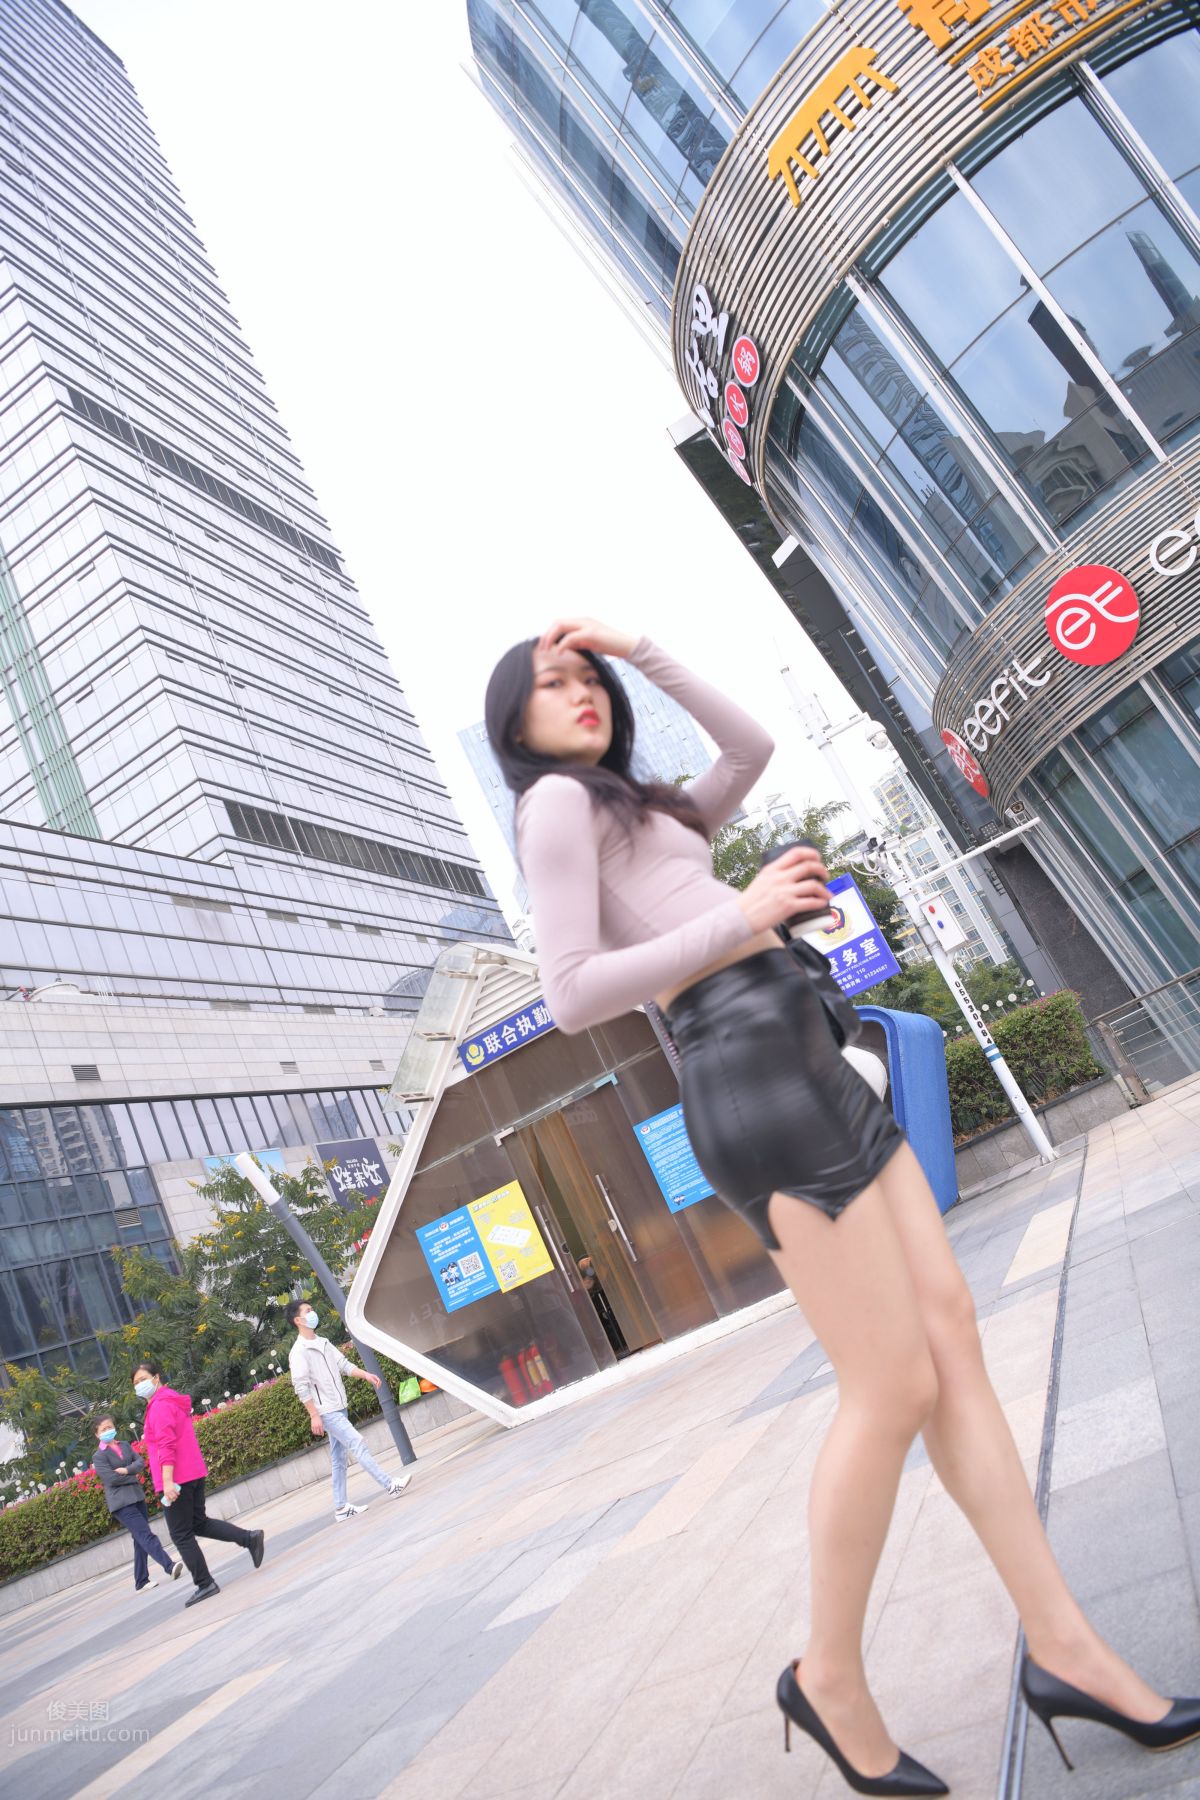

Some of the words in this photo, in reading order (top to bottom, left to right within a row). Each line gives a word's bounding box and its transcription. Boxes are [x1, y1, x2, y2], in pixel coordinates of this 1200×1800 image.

[963, 656, 1053, 752] eefit
[483, 1004, 552, 1054] 联合执勤
[954, 980, 993, 1044] 05530084
